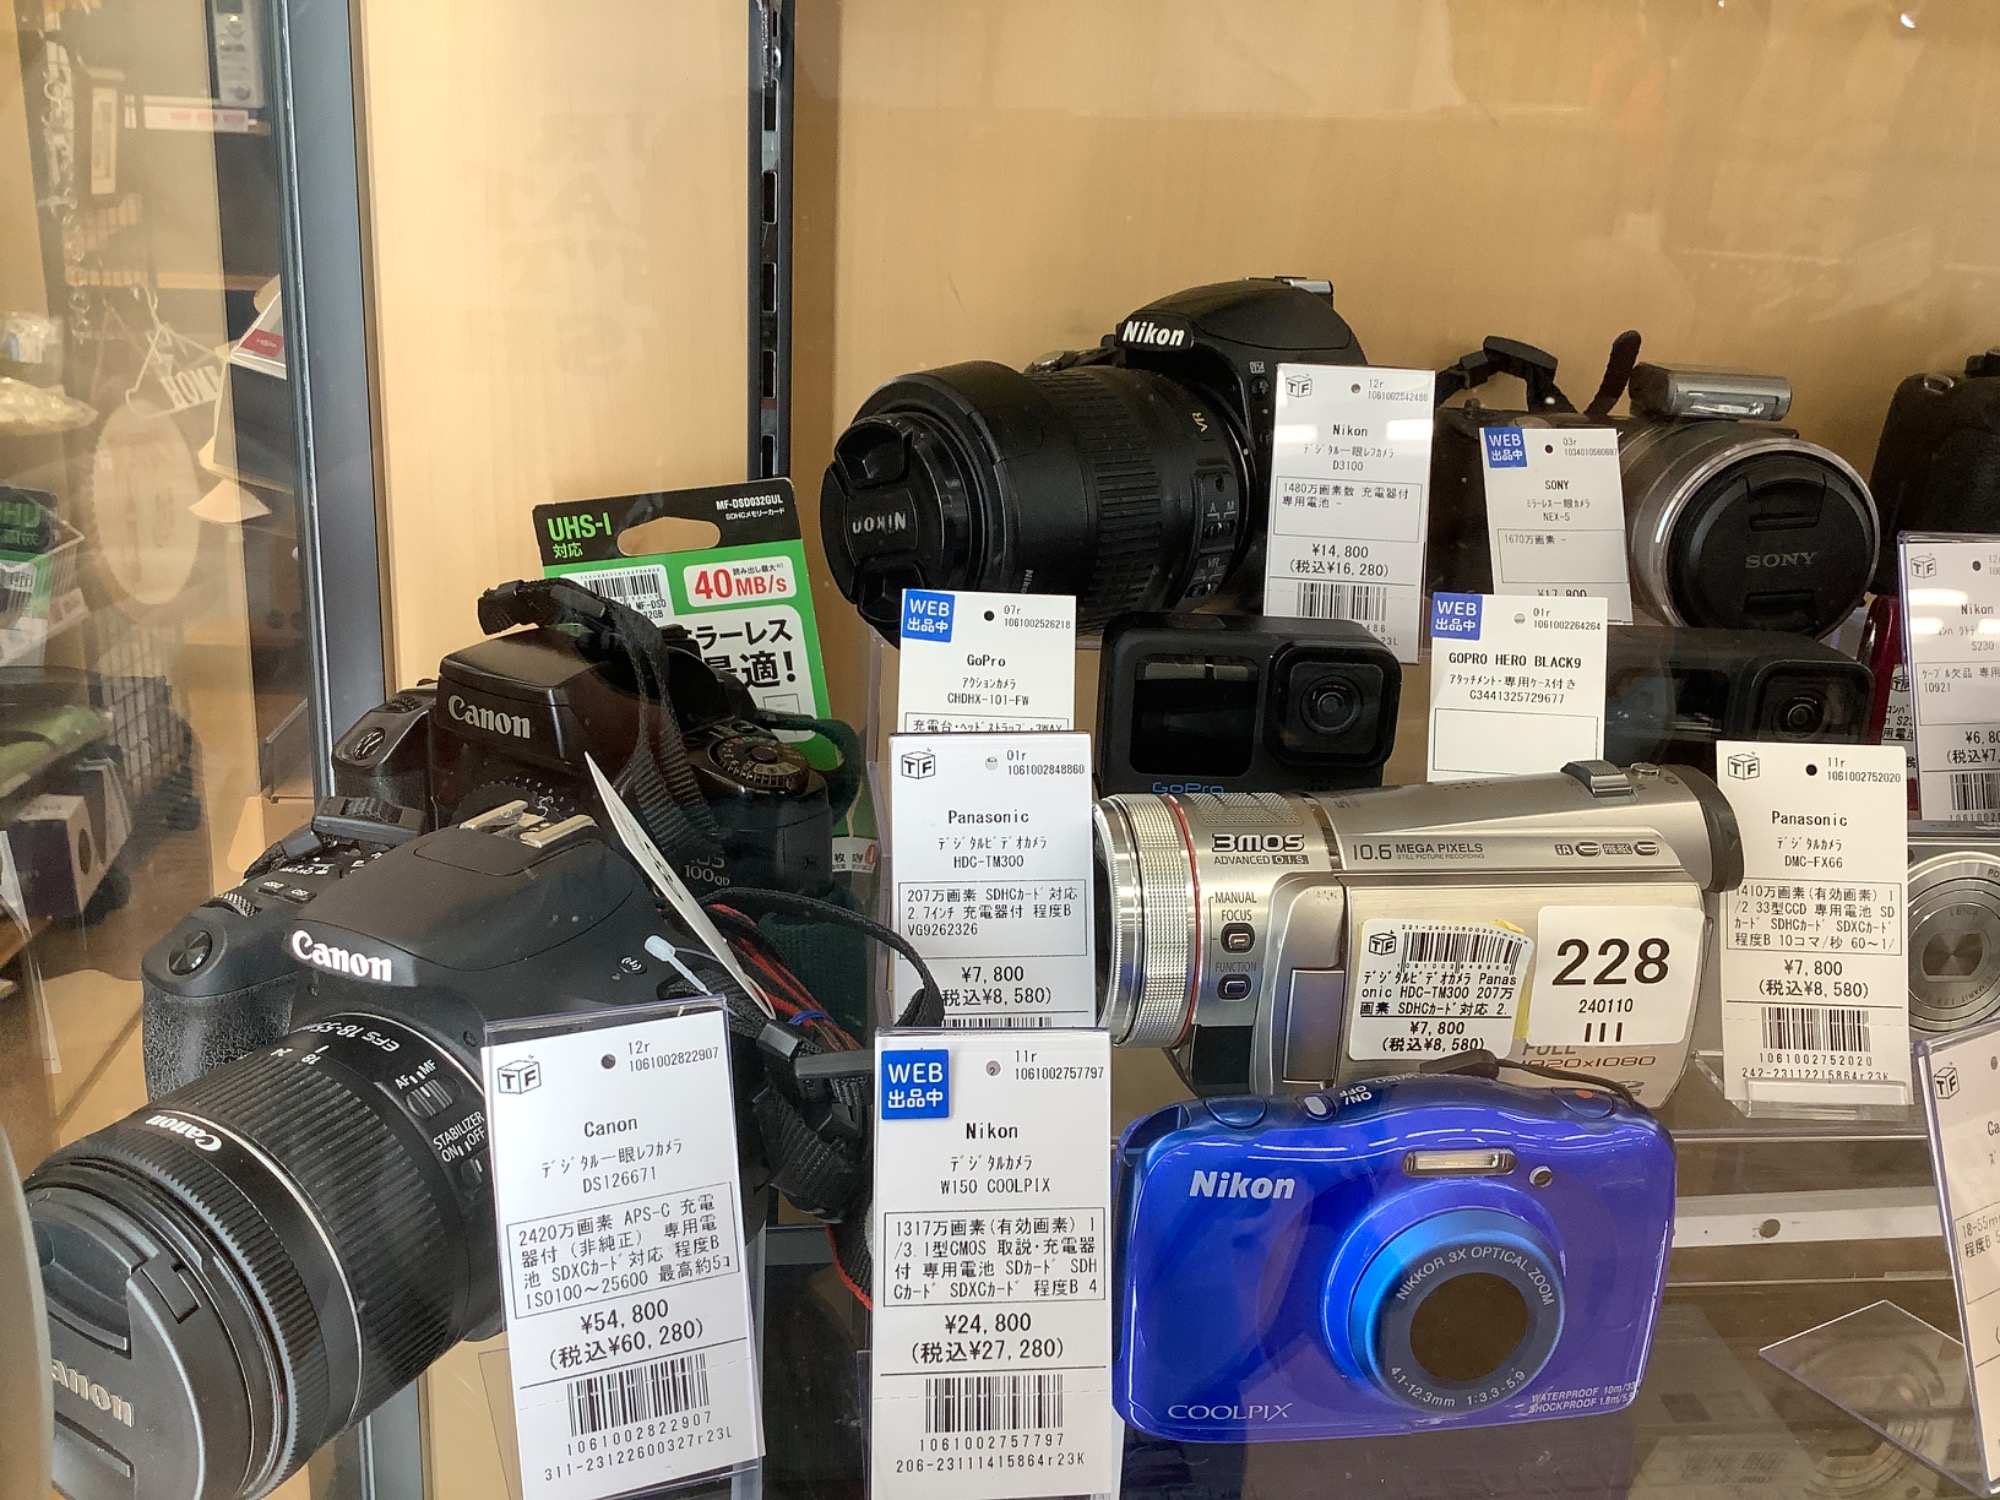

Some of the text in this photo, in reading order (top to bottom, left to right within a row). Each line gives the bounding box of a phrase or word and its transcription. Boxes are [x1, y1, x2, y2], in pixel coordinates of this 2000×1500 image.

[1122, 320, 1186, 348] Nikon
[1369, 378, 1384, 388] 12r
[1332, 424, 1368, 437] Nikon
[1489, 433, 1522, 447] WEB
[1491, 449, 1523, 462] 出品中
[1332, 461, 1364, 471] D3100
[1283, 482, 1409, 500] 1480万画素数 充電器付
[1545, 479, 1569, 490] SONY
[716, 494, 783, 510] MF-DSD032GUL
[1282, 496, 1330, 508] 専用電池
[1543, 511, 1571, 521] NEX-5
[547, 512, 612, 541] UHS-I
[552, 542, 583, 559] 対応
[1312, 543, 1369, 559] ¥14,800
[1289, 559, 1389, 578] (税込¥16,280)
[1745, 551, 1818, 569] SONY
[909, 598, 950, 617] WEB
[1004, 604, 1021, 615] 07r
[1437, 600, 1477, 616] WEB
[1961, 604, 1994, 615] Nikon
[907, 617, 949, 634] 出品中
[1435, 617, 1476, 632] 出品中
[688, 619, 793, 651] ラーレス
[1971, 641, 1995, 652] S230
[967, 653, 1006, 668] GoPro
[1448, 652, 1582, 669] GOPRO HERO BLACK9
[961, 676, 1017, 690] アクションカメラ
[1924, 682, 1951, 693] 10921
[946, 692, 1029, 706] CHDHX-101-FW
[1469, 689, 1565, 704] C3441325729677
[448, 693, 532, 739] Canon
[1006, 750, 1028, 761] 01r
[1007, 764, 1085, 776] 1061002848860
[1827, 771, 1901, 783] 1061002752020
[1152, 782, 1225, 794] GoPro
[948, 808, 1029, 824] Panasonic
[1771, 810, 1848, 826] Panasonic
[938, 835, 1048, 851] デジタルビデオカメラ
[1396, 842, 1483, 853] MEGA PIXELS
[1777, 836, 1843, 851] デジタルカメラ
[1214, 855, 1270, 865] ADVANCED
[1353, 844, 1392, 860] 10.6
[953, 855, 1024, 869] HDC-TM300
[1784, 855, 1843, 868] DMC-FX66
[907, 886, 1079, 903] 207万画素 SDHCカード対応
[1215, 891, 1257, 904] MANUAL
[907, 904, 1072, 920] 2.7インチ 充電器付 程度B
[1221, 910, 1252, 921] FOCUS
[1814, 903, 1895, 919] 専用電池 SD
[907, 923, 978, 936] VG9262326
[1734, 917, 1892, 935] カード SDHCカード SDXCカード
[1735, 932, 1843, 949] 程度B 10コマ/秒
[292, 929, 393, 982] Canon
[1552, 937, 1670, 985] 228
[961, 966, 1024, 983] ¥7,800
[1215, 961, 1257, 973] FUNCTION
[1784, 959, 1842, 976] ¥7,800
[1364, 970, 1517, 985] デジタルビデオカメラ Panas
[1362, 986, 1514, 1000] onic HDC-TM300 207万
[1758, 978, 1869, 999] (税込¥8,580)
[1398, 1001, 1489, 1016] SDHCカード対応
[1578, 998, 1633, 1013] 240110
[1410, 1021, 1465, 1036] ¥7,800
[628, 1041, 650, 1055] 12r
[1382, 1038, 1484, 1052] (税込¥8,580)
[629, 1047, 719, 1072] 1061002822907
[1015, 1050, 1037, 1063] 11r
[395, 1059, 436, 1090] AF MF
[888, 1062, 943, 1084] WEB
[1015, 1066, 1104, 1080] 1061002757797
[888, 1087, 944, 1109] 出品中
[1339, 1085, 1367, 1098] OFF
[145, 1114, 222, 1152] Canon
[433, 1111, 485, 1151] STABILIZER
[584, 1118, 638, 1138] Canon
[966, 1122, 1018, 1140] Nikon
[441, 1126, 485, 1163] ON OFF
[541, 1138, 683, 1178] デジタル一眼レフカメラ
[950, 1154, 1033, 1172] デジタルカメラ
[583, 1166, 657, 1194] DS126671
[940, 1177, 1051, 1195] W150 COOLPIX
[1189, 1168, 1295, 1200] Nikon
[518, 1193, 715, 1247] 2420万画素 APS-C 充電
[663, 1213, 718, 1239] 専用電
[896, 1216, 1076, 1237] 1317万画素(有効画素)
[894, 1236, 1096, 1260] /3.1型CMOS 取説・充電器
[1964, 1235, 1992, 1258] 程度B
[523, 1234, 720, 1290] 池 SDXCカード対応 程度B
[658, 1255, 731, 1283] 最高約5コ
[895, 1257, 1098, 1280] 付 専用電池 SDカード SDH
[1396, 1246, 1554, 1306] NIKKOR 3X OPTICAL ZOOM
[894, 1278, 1098, 1300] Cカード SDXCカード 程度B 4
[580, 1298, 669, 1334] ¥54,800
[945, 1312, 1032, 1335] ¥24,800
[550, 1317, 704, 1370] (税込¥60,280)
[912, 1337, 1064, 1364] (税込¥27,280)
[51, 1357, 135, 1428] anon
[1391, 1366, 1456, 1407] 4.1-12.3mm
[1531, 1380, 1641, 1403] WATERPROOF 10m/33
[1168, 1400, 1294, 1422] COOLPIX
[1528, 1397, 1597, 1414] SHOCKPROOF
[566, 1410, 712, 1456] 1061002822907
[919, 1433, 1064, 1452] 1061002757797
[544, 1426, 733, 1481] 311-23122600327r23L
[896, 1452, 1085, 1474] 206-23111415864r23K
